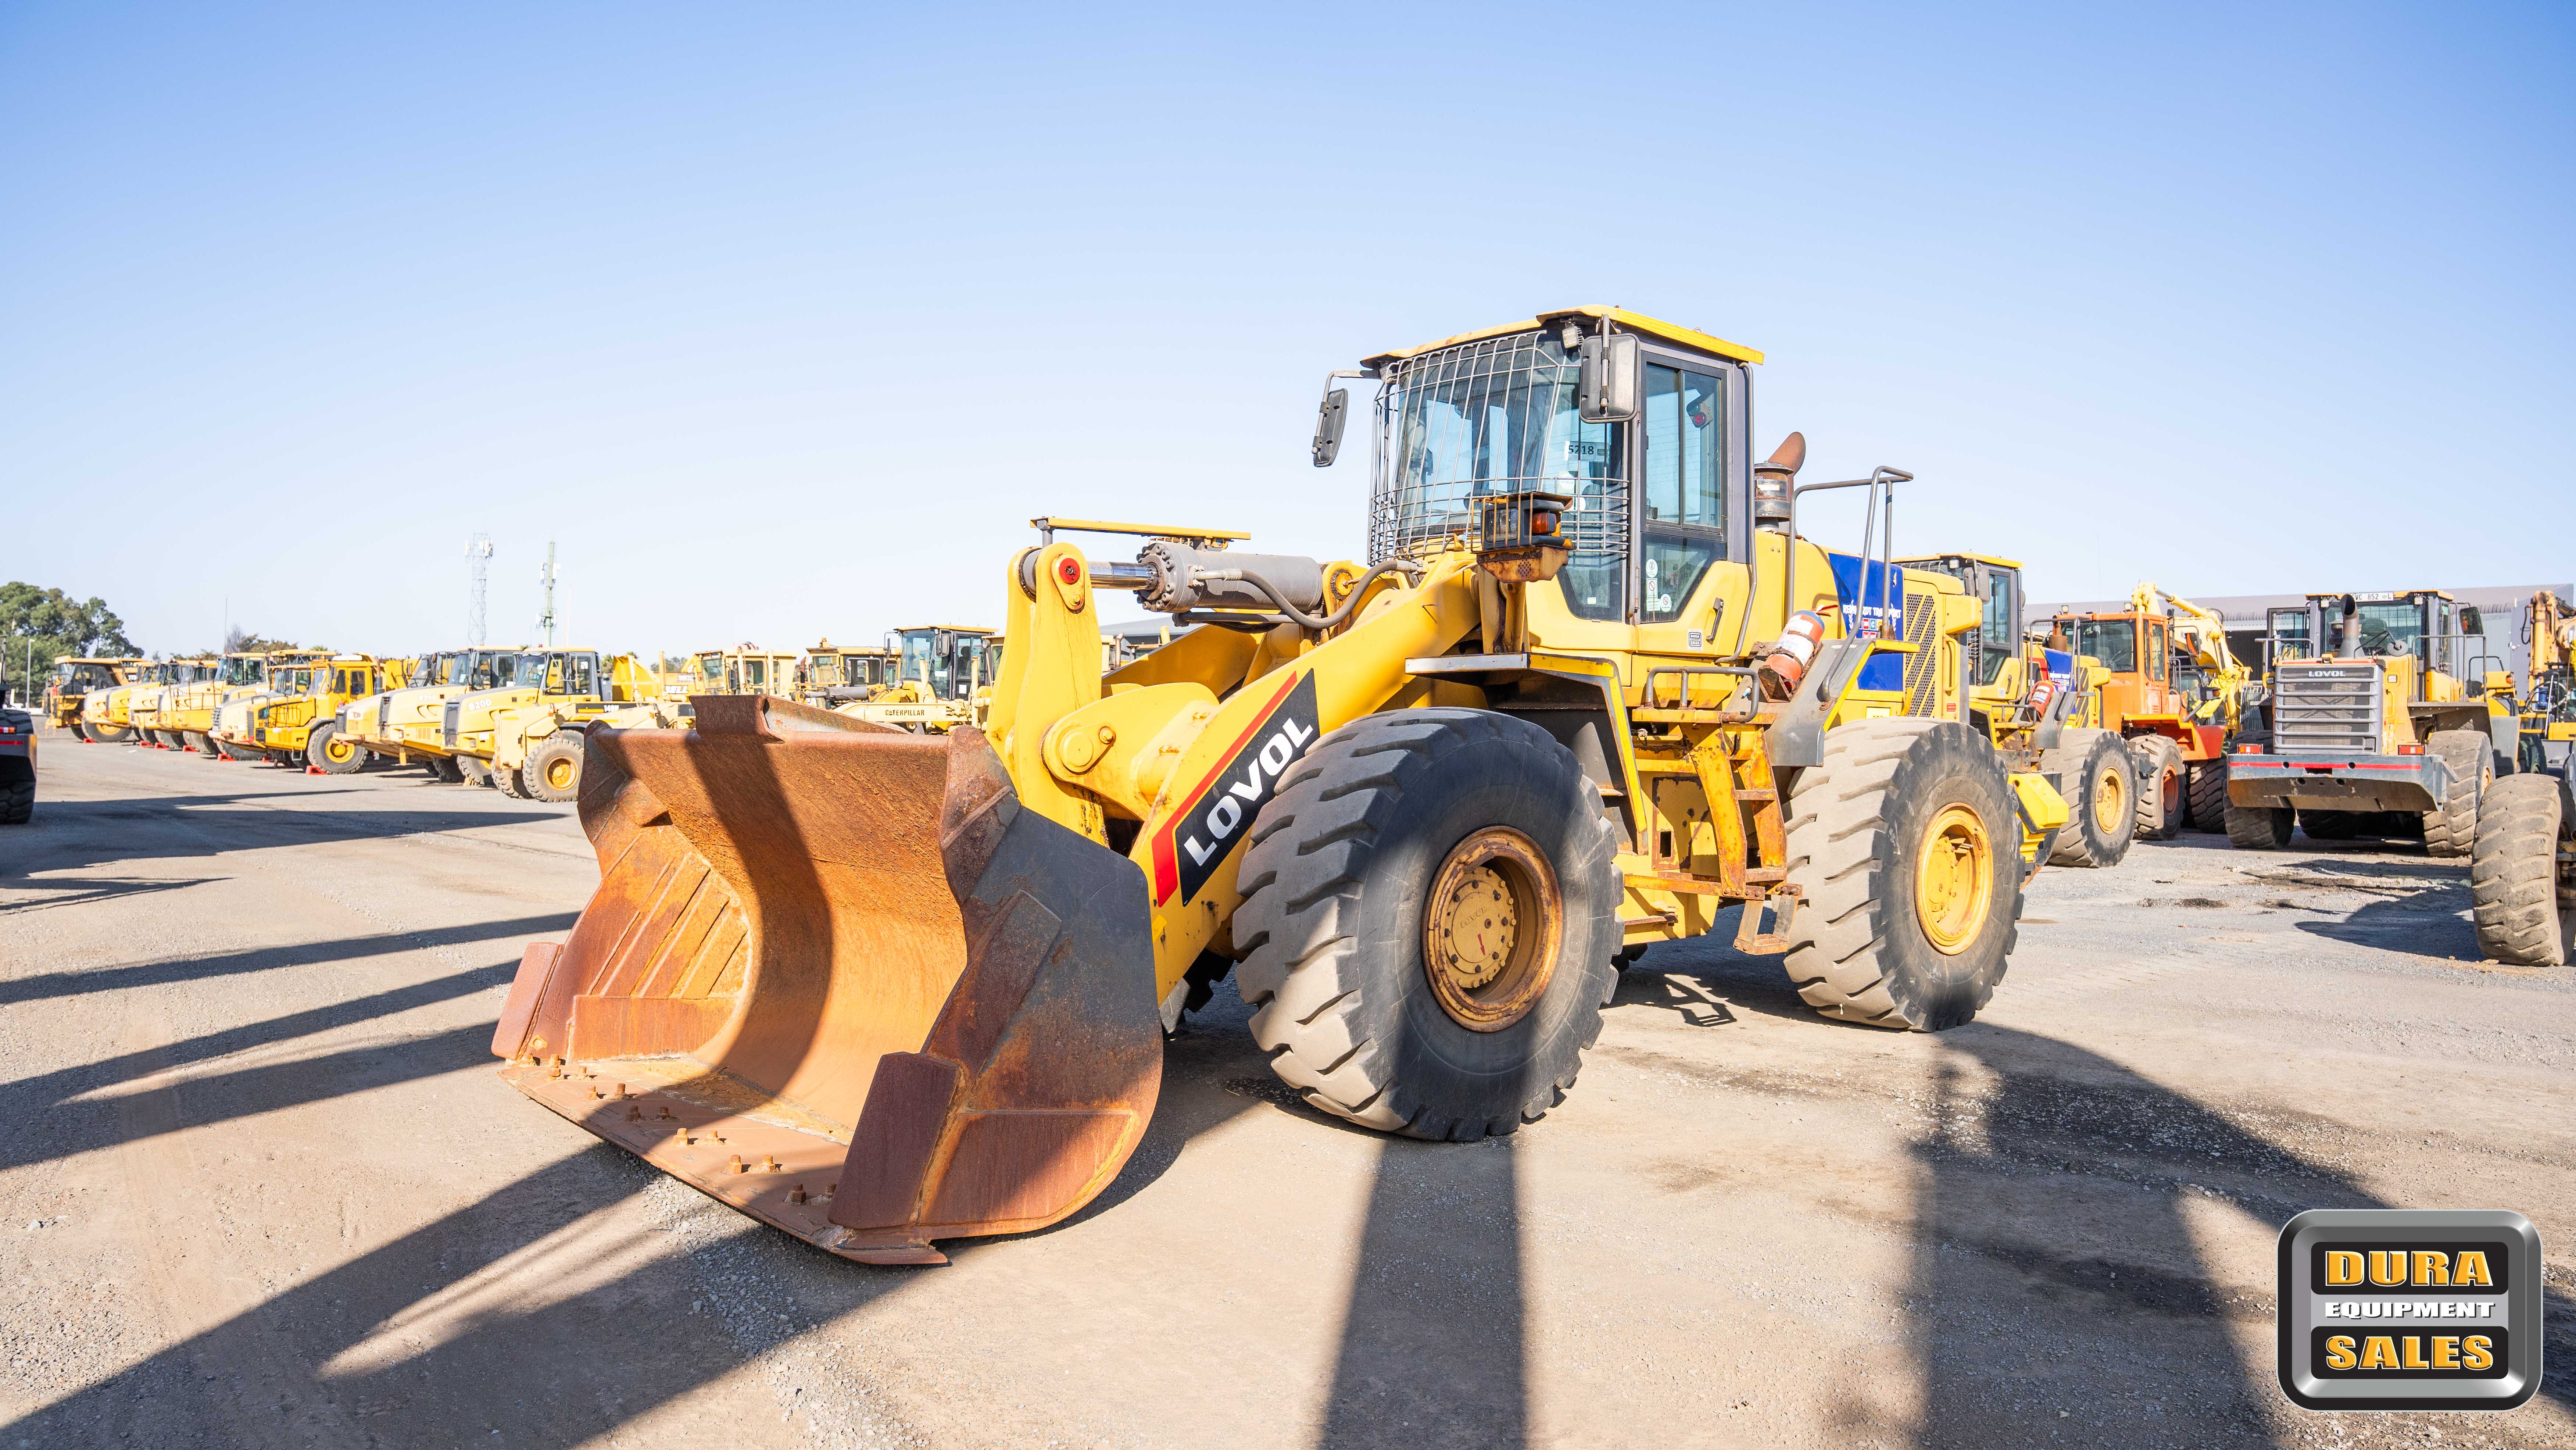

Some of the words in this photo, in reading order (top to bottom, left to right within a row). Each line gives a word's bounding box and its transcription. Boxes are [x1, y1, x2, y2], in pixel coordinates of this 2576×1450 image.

[1568, 444, 1594, 455] 5218
[1872, 607, 1901, 619] TRAPORT
[665, 685, 688, 694] BELL
[468, 699, 492, 711] B20D
[1184, 718, 1313, 866] LOVOL
